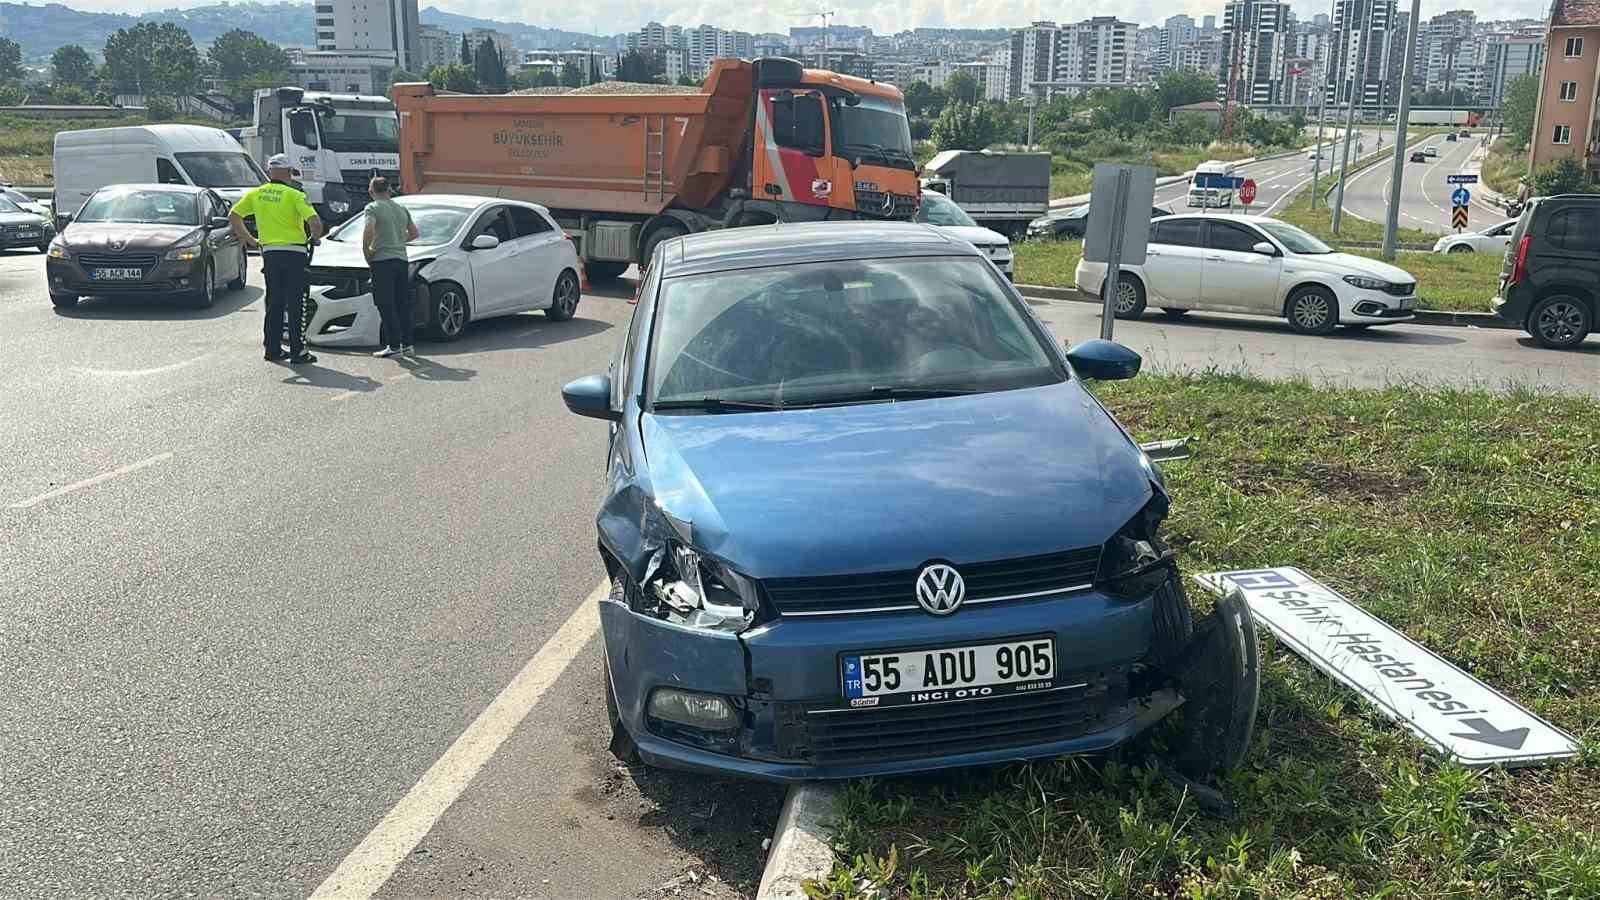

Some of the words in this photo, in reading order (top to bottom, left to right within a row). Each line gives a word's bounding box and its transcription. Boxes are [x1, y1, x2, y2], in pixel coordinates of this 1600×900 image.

[674, 117, 689, 137] 7
[1240, 187, 1255, 198] DUR
[1259, 590, 1343, 626] Şehir
[1328, 632, 1488, 716] Hastanesi
[863, 656, 900, 691] 55
[923, 650, 976, 687] ADU
[996, 643, 1051, 680] 905
[847, 680, 862, 690] TR
[955, 687, 993, 698] OTO
